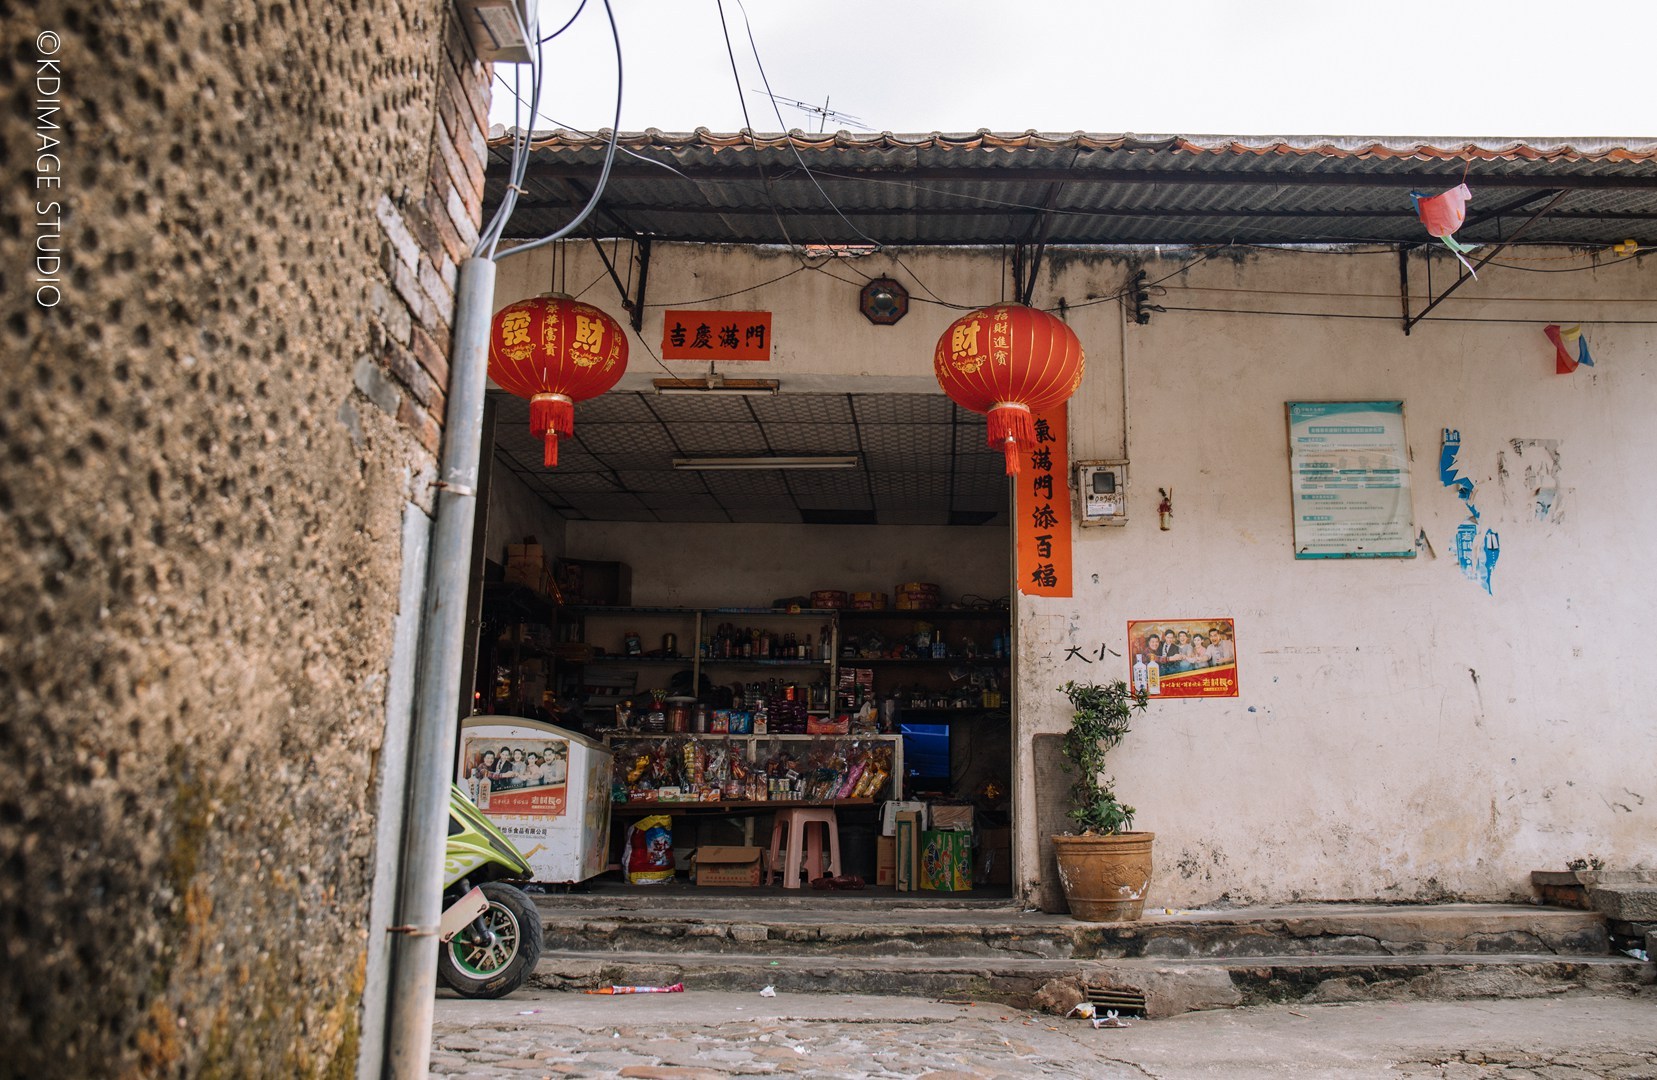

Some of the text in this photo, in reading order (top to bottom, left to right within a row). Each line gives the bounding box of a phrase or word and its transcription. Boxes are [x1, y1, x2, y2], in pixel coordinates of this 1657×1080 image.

[501, 310, 532, 347] 發
[572, 314, 605, 355] 財
[951, 320, 981, 361] 財
[1064, 643, 1121, 664] 大小
